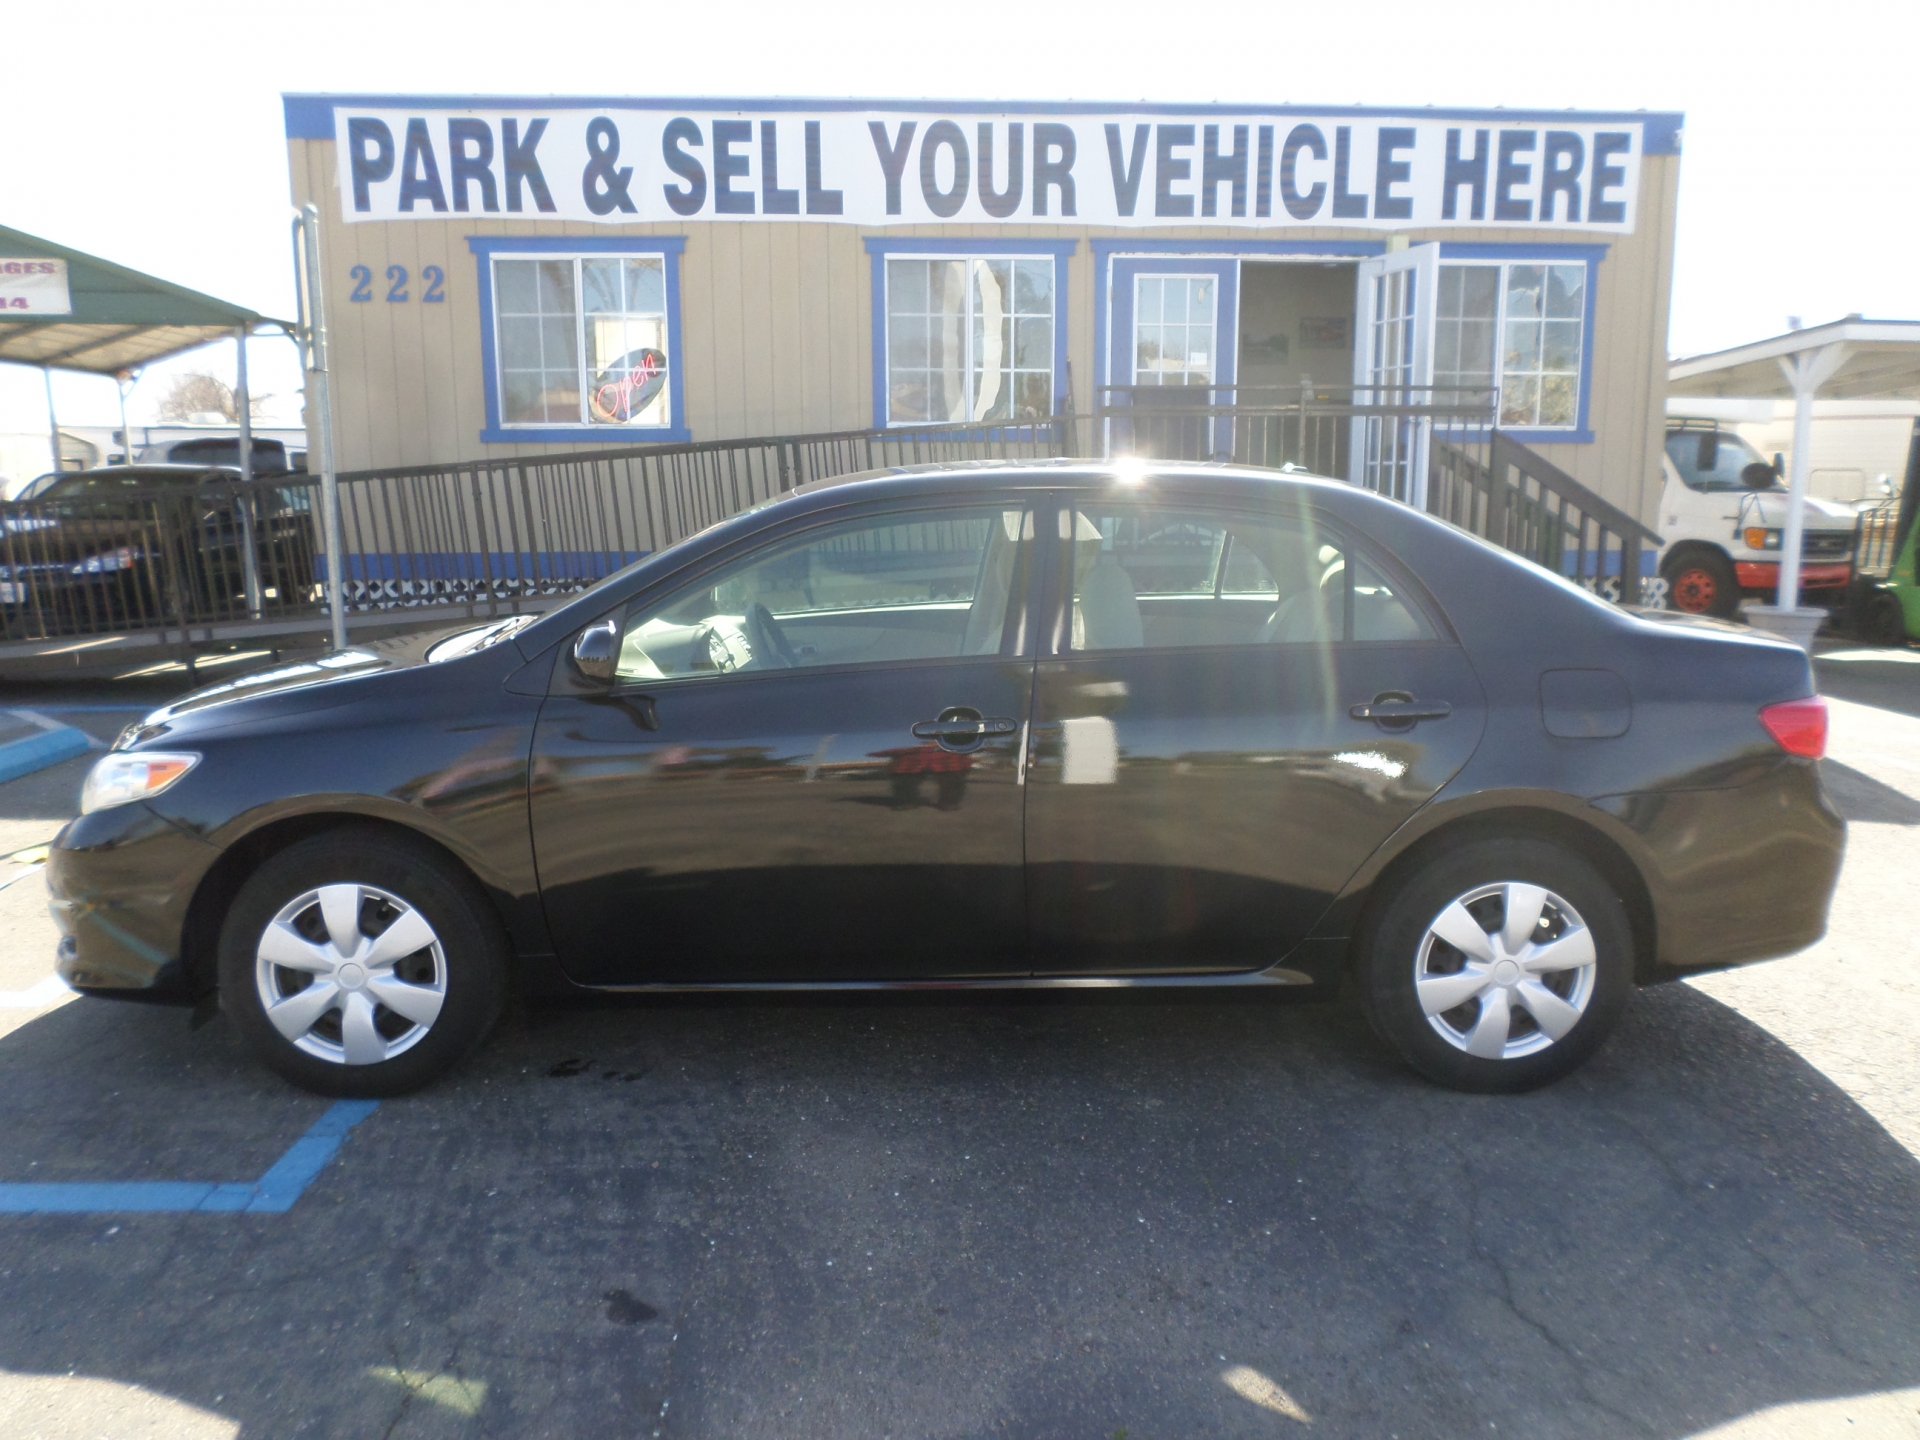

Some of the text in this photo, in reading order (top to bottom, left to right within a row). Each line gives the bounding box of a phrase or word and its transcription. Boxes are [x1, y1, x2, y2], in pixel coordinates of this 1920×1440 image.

[347, 116, 1632, 224] PARK & SELL YOUR VEHICLE HERE
[0, 261, 56, 274] GES
[349, 264, 446, 303] 222
[596, 352, 657, 417] Open
